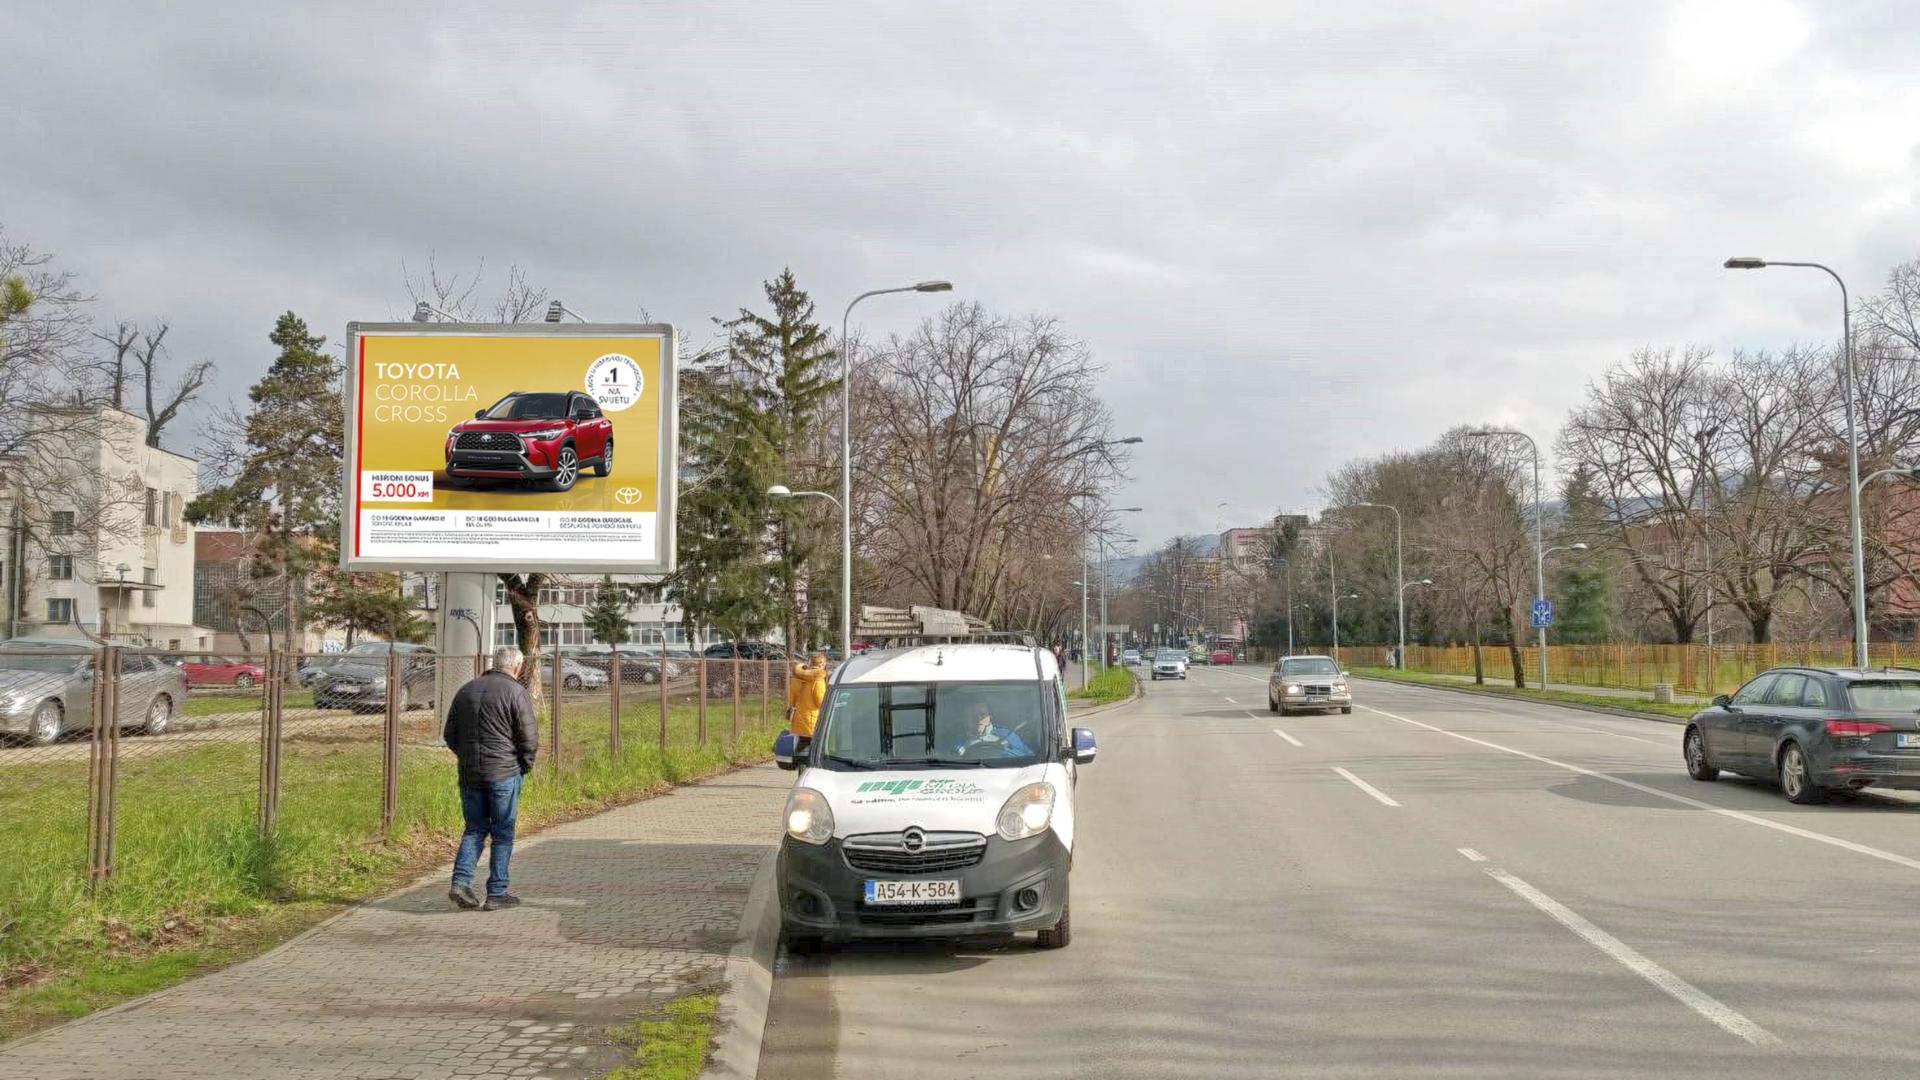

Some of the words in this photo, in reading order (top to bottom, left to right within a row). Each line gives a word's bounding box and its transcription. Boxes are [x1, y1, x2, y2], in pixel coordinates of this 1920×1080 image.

[374, 362, 460, 380] TOYOTA
[375, 383, 478, 401] COROLLA
[375, 404, 448, 423] CROSS
[404, 474, 430, 482] BONUS
[372, 483, 417, 498] 5.000
[877, 881, 956, 899] A54-K-584
